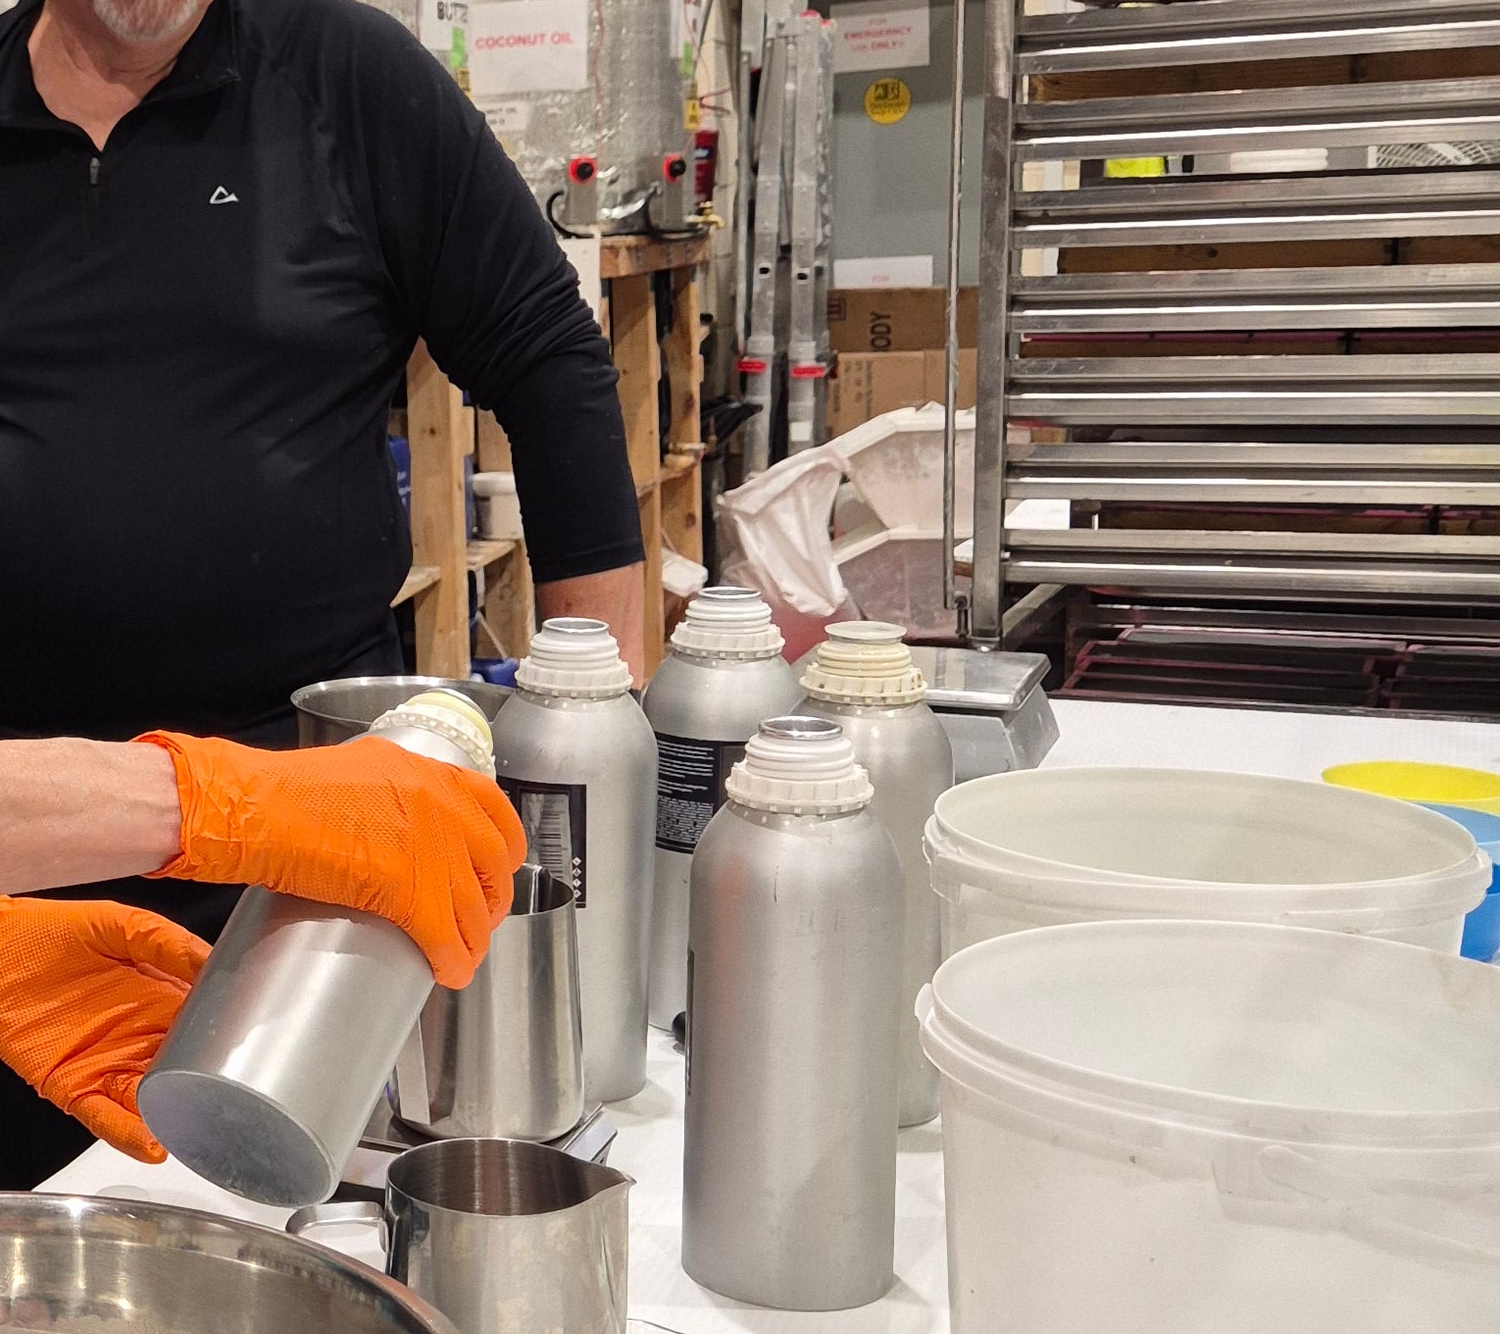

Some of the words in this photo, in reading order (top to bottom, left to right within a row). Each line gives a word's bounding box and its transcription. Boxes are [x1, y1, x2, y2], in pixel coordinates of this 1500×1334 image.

[475, 32, 546, 50] COCONUT
[550, 31, 573, 45] OIL
[869, 310, 892, 352] ODY
